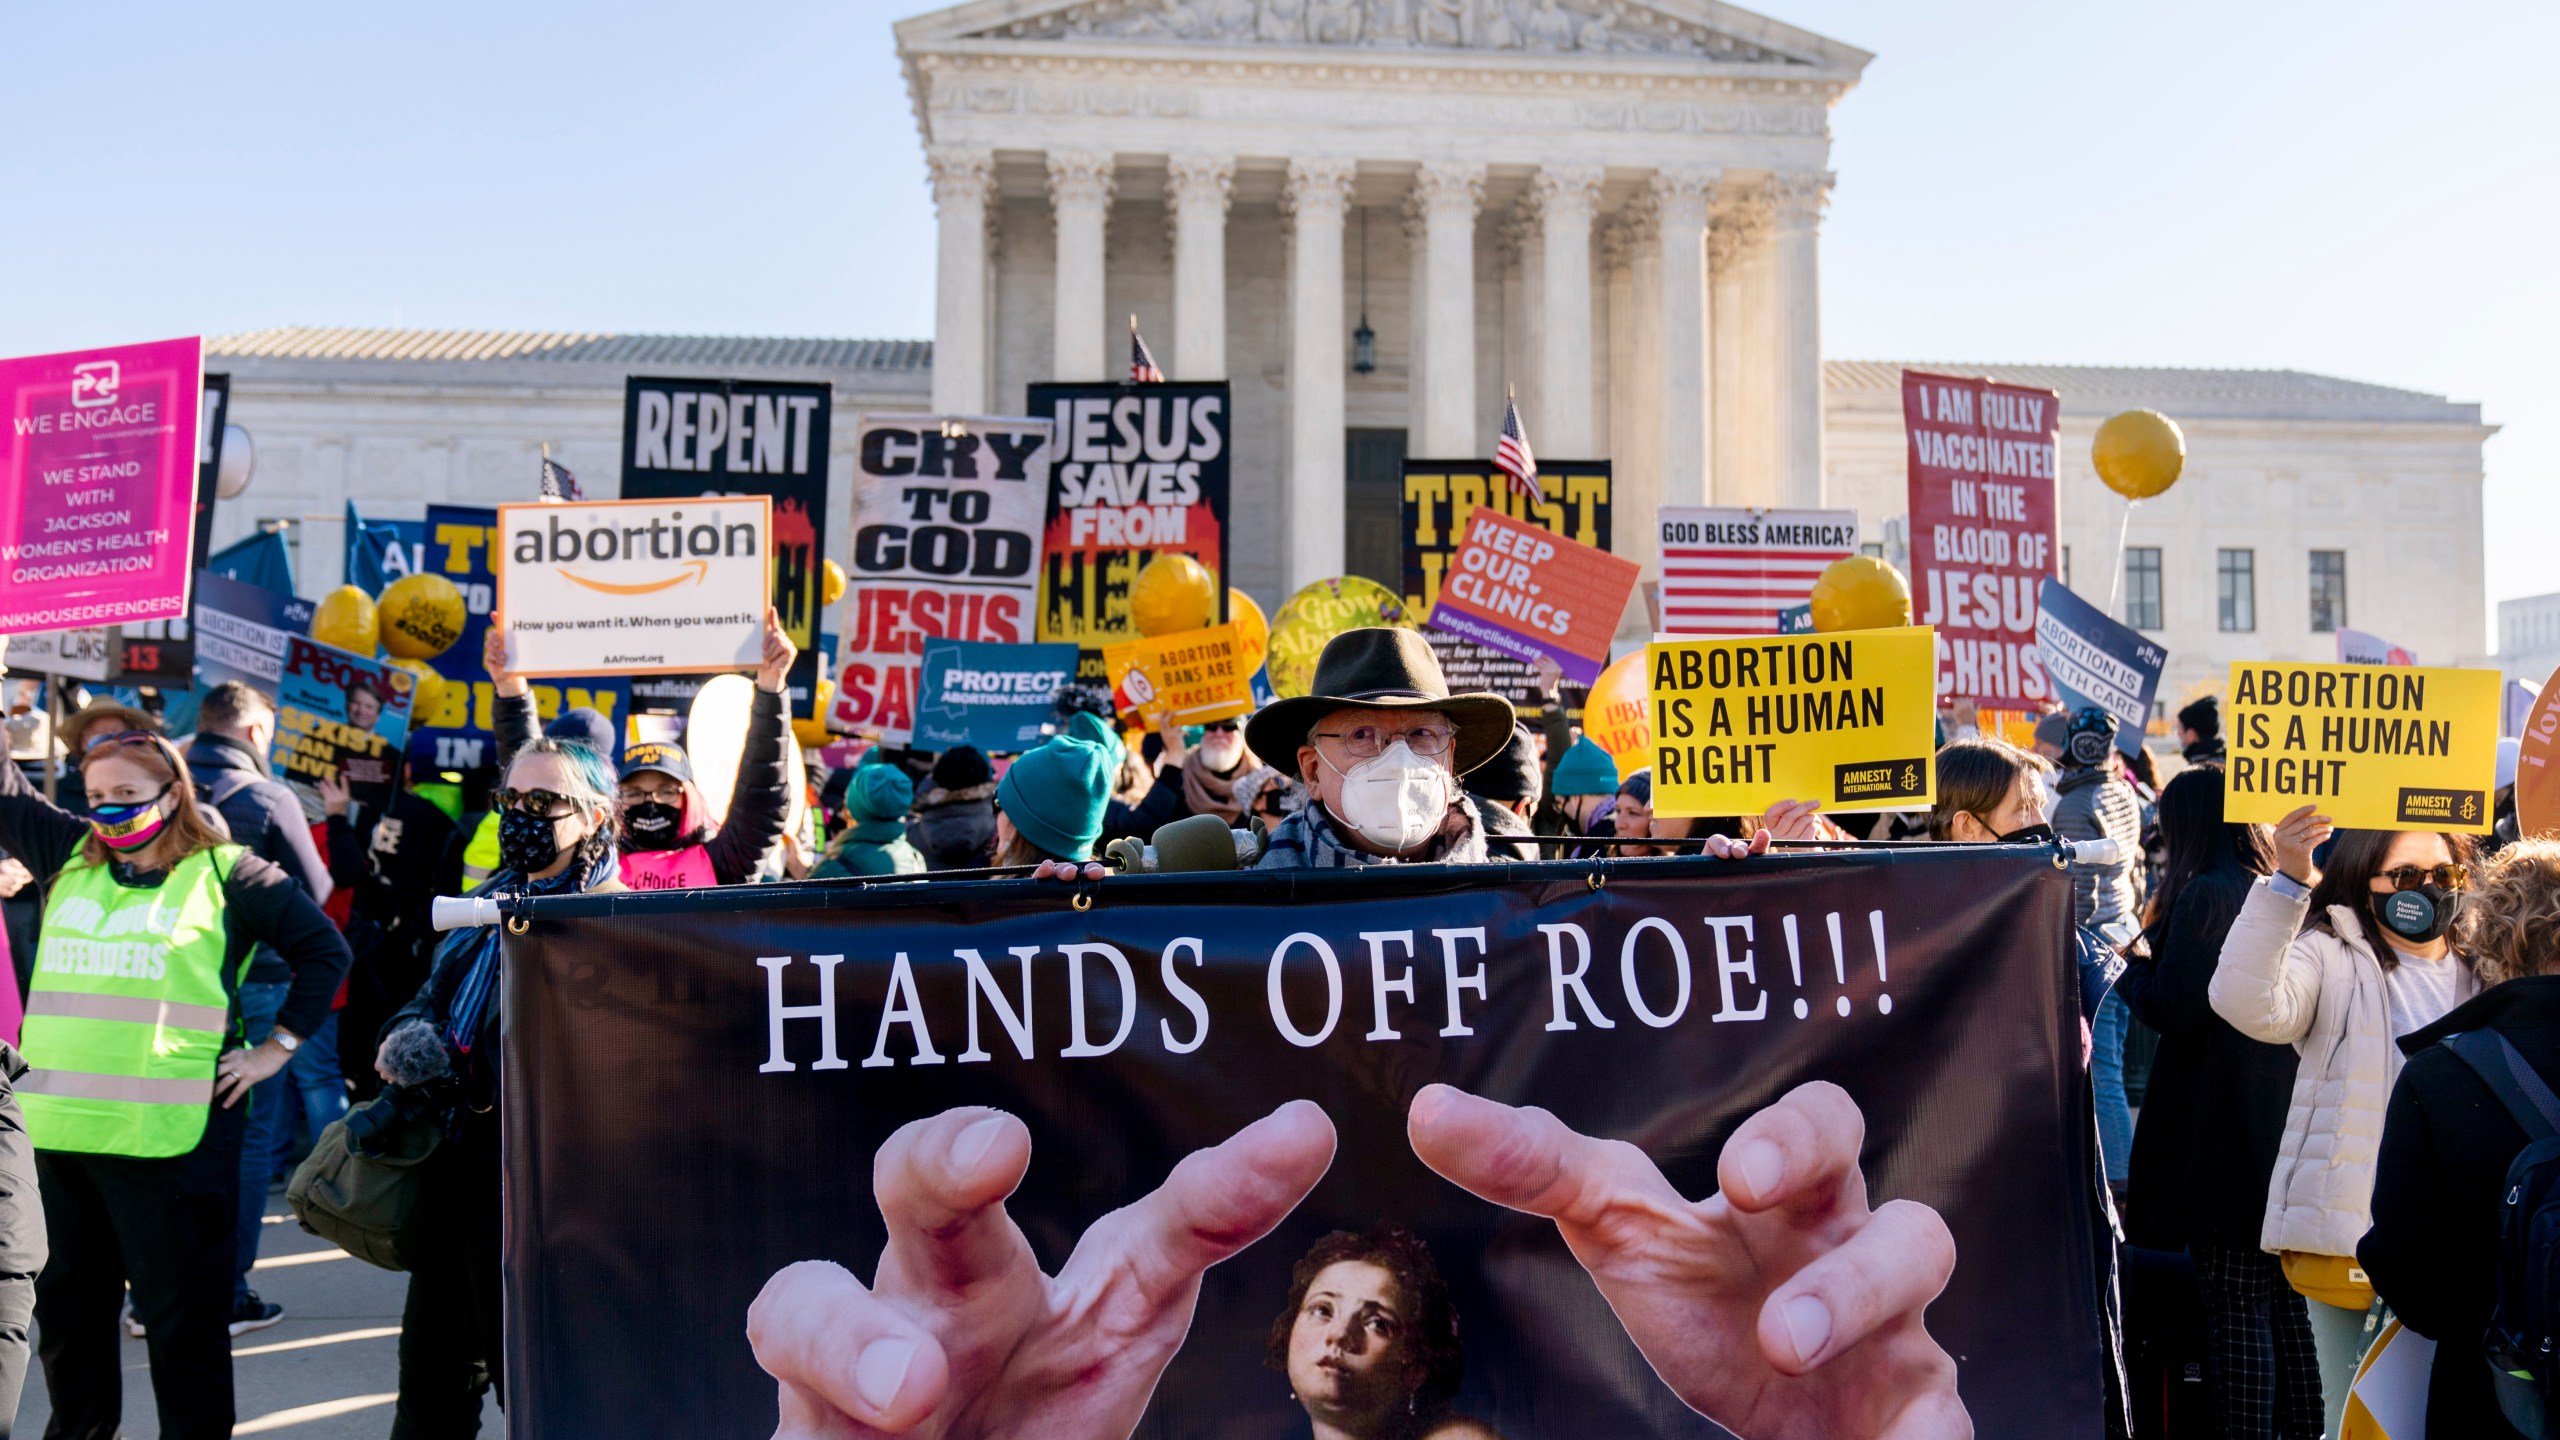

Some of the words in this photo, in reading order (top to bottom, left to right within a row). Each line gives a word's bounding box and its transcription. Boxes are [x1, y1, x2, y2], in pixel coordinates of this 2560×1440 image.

[14, 414, 54, 436] WE
[59, 403, 157, 431] ENGAGE
[1919, 384, 1930, 420] I
[1937, 386, 1974, 427] AM
[1981, 389, 2044, 433] FULLY
[635, 390, 819, 475] REPENT
[1050, 396, 1222, 463] JESUS
[861, 427, 1046, 481] CRY
[1914, 429, 2055, 480] VACCINATED
[43, 468, 74, 485] WE
[77, 461, 141, 482] STAND
[1059, 461, 1200, 508] SAVES
[66, 488, 114, 506] WITH
[902, 487, 990, 524] TO
[1405, 474, 1608, 547] TRUST
[1951, 479, 1977, 518] IN
[1981, 483, 2027, 523] THE
[43, 510, 131, 533] JACKSON
[513, 511, 756, 563] abortion
[1070, 505, 1187, 547] FROM
[1662, 522, 1699, 543] GOD
[1705, 523, 1759, 545] BLESS
[1764, 525, 1855, 547] AMERICA?
[2, 537, 93, 560] WOMEN'S
[96, 528, 169, 551] HEALTH
[855, 525, 1033, 578] GOD
[1471, 518, 1555, 565] KEEP
[1933, 524, 2011, 570] BLOOD
[2017, 530, 2048, 571] OF
[12, 554, 154, 584] ORGANIZATION
[0, 596, 182, 628] NKHOUSEDEFENDERS
[1297, 594, 1383, 630] Grow
[1451, 572, 1572, 635] CLINICS
[1923, 569, 2046, 633] JESU
[201, 612, 267, 644] ABORTION
[268, 635, 283, 650] IS
[512, 620, 544, 631] How
[546, 620, 574, 632] you
[576, 618, 611, 629] want
[613, 617, 629, 629] it.
[630, 616, 671, 628] When
[673, 616, 701, 628] you
[704, 614, 739, 625] want
[741, 613, 756, 624] it.
[851, 589, 1020, 654] JESUS
[1436, 611, 1546, 659] KeepOurClinics.org
[203, 640, 249, 663] HEALTH
[253, 660, 279, 676] CAR
[603, 655, 665, 665] AAFront.org
[1160, 641, 1232, 667] ABORTION
[1446, 659, 1482, 672] under
[1483, 659, 1526, 673] heaven
[1654, 640, 1853, 691] ABORTION
[2041, 618, 2117, 679] ABORTION
[2119, 669, 2137, 691] IS
[943, 668, 1067, 693] PROTECT
[1164, 666, 1203, 687] BANS
[1208, 661, 1236, 677] ARE
[2041, 644, 2088, 691] HEALTH
[2092, 683, 2138, 722] CARE
[2235, 669, 2425, 712] ABORTION
[940, 691, 1008, 706] ABORTION
[1171, 681, 1243, 708] RACIST.
[1658, 698, 1694, 739] IS
[1708, 697, 1733, 738] A
[1748, 687, 1884, 737] HUMAN
[275, 730, 335, 762] MAN
[279, 706, 388, 758] SEXIST
[2236, 712, 2271, 750] IS
[2284, 714, 2307, 750] A
[2321, 716, 2451, 757] HUMAN
[272, 750, 337, 780] ALIVE
[434, 736, 485, 769] IN
[1658, 744, 1777, 785] RIGHT
[1843, 768, 1893, 785] AMNESTY
[1843, 782, 1893, 794] INTERNATIONAL
[2232, 757, 2347, 797] RIGHT
[2405, 795, 2452, 809] AMNESTY
[2405, 808, 2451, 818] INTERNATIONAL
[2395, 912, 2418, 921] Access
[2396, 906, 2424, 917] Abortion
[2397, 900, 2420, 911] Protect
[41, 936, 169, 980] DEFENDERS
[757, 937, 1209, 1072] HANDS
[1267, 927, 1487, 1047] OFF
[1537, 908, 1894, 1033] ROE!!!
